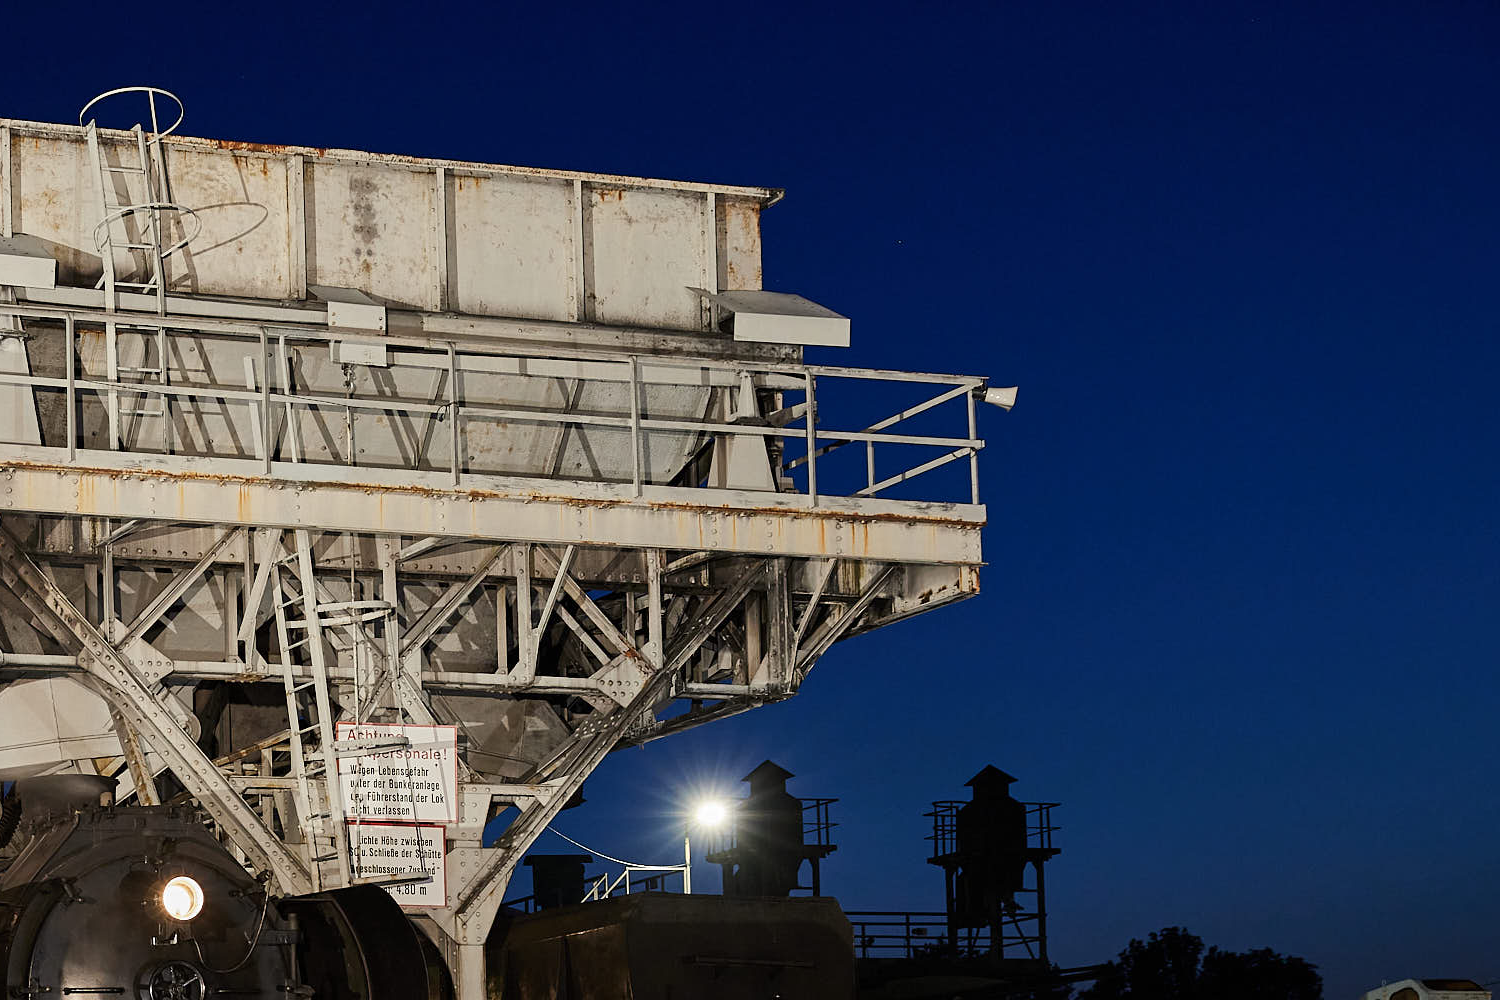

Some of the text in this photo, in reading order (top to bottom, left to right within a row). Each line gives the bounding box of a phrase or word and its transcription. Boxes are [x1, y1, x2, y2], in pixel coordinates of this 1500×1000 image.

[378, 765, 429, 777] Lebensgefahr
[374, 779, 386, 788] der
[416, 793, 428, 803] der
[431, 793, 445, 804] Lok
[374, 805, 410, 816] verlassen
[358, 835, 378, 845] ichte
[381, 835, 398, 846] Höhe
[401, 849, 412, 858] der
[419, 886, 427, 896] m
